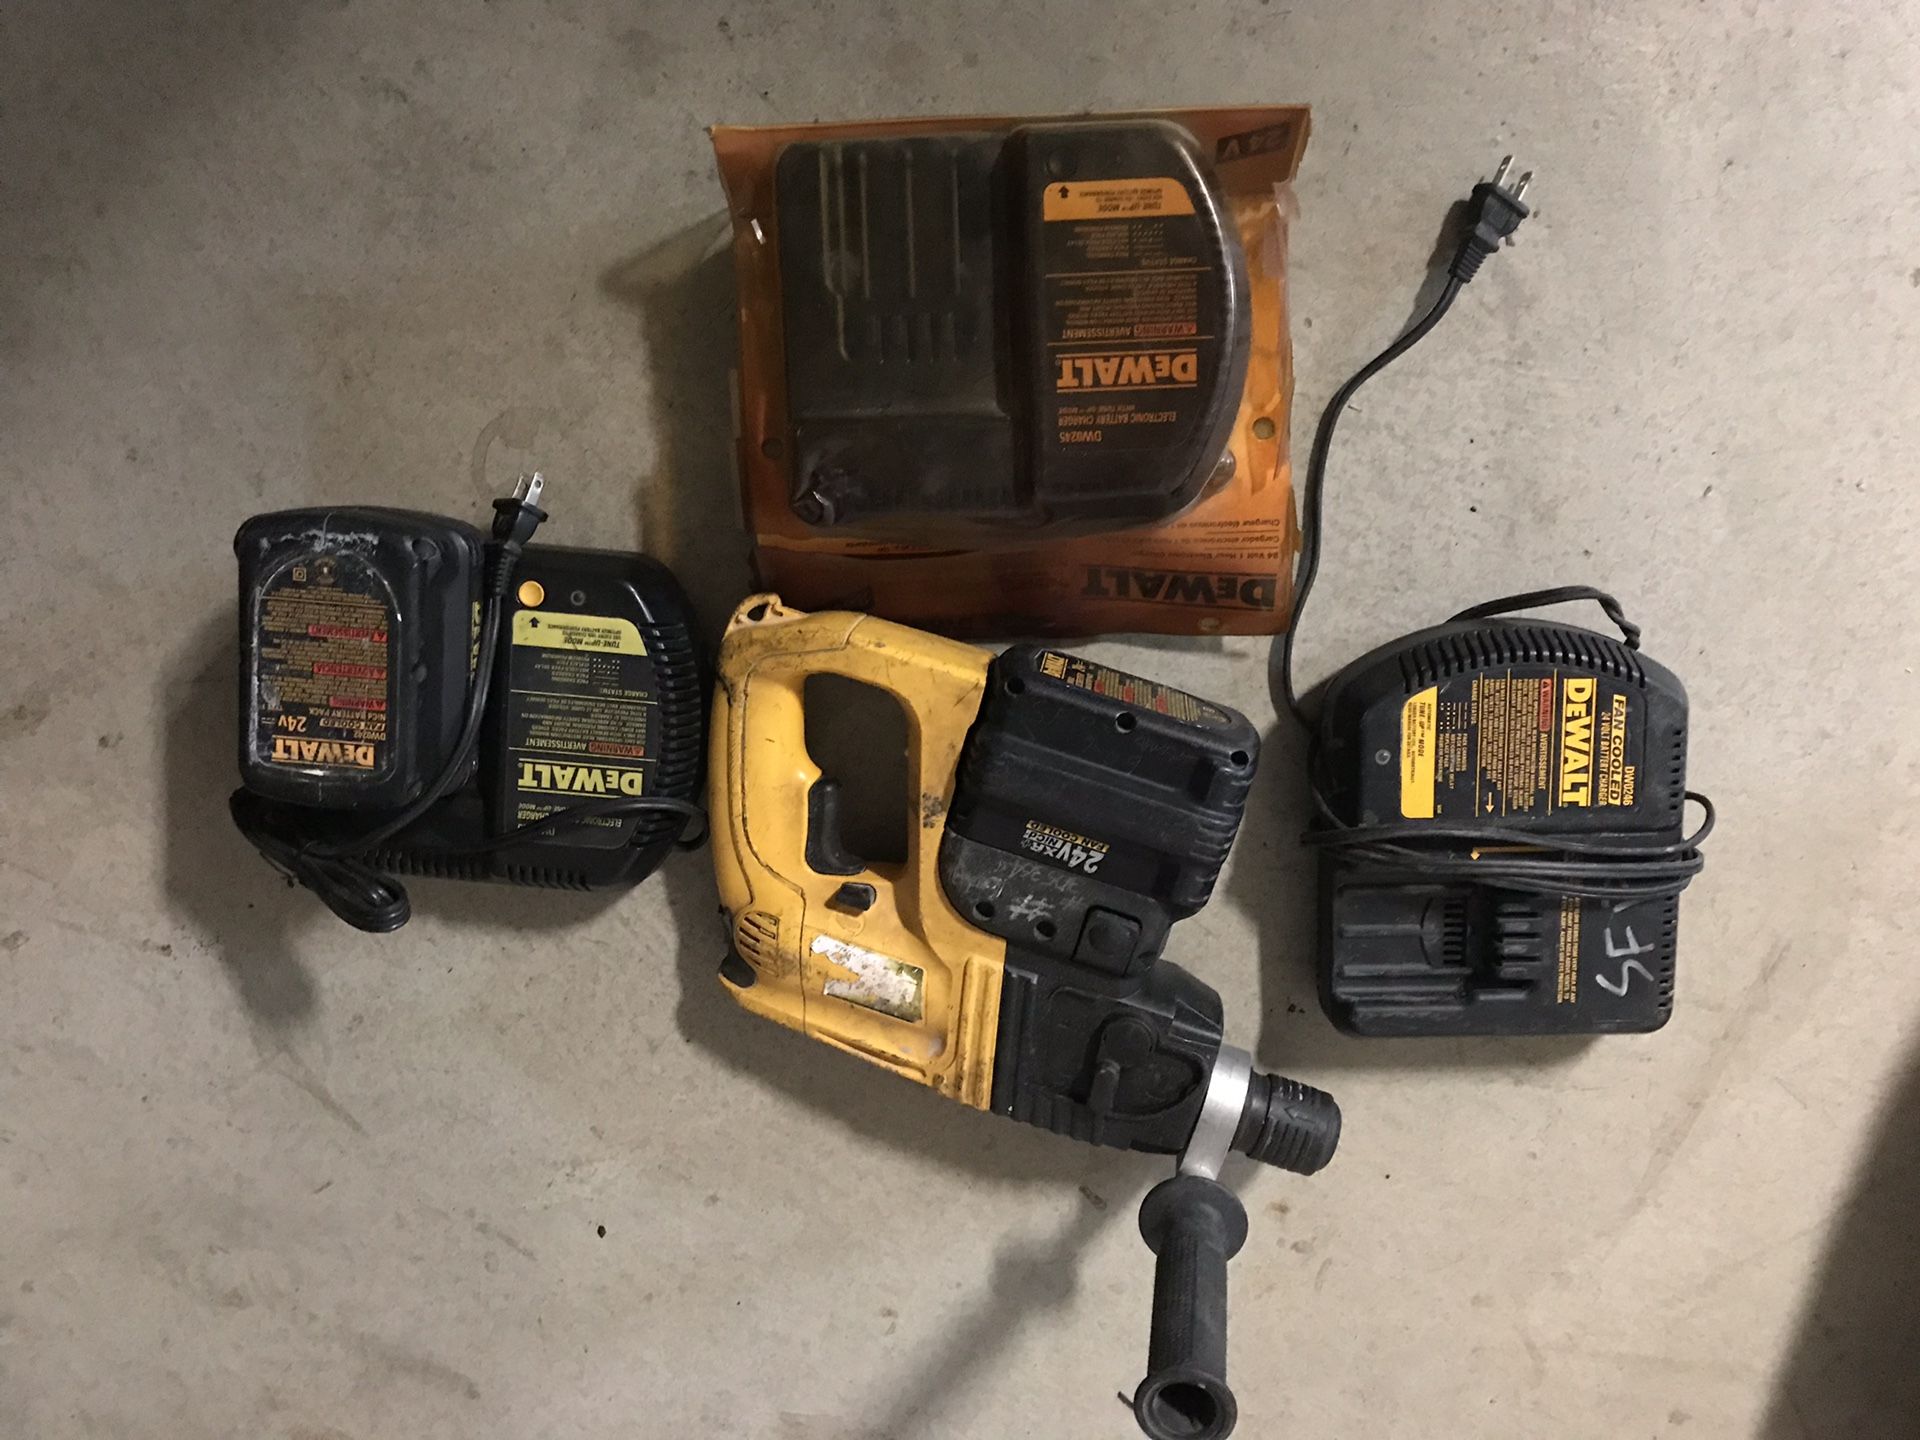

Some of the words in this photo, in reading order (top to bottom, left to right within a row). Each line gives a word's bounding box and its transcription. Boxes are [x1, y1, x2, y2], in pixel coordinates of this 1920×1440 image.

[1062, 327, 1131, 338] AVERTISSEMENT
[1057, 354, 1197, 387] DEWALT
[1058, 415, 1093, 426] CHARGER
[1097, 414, 1128, 424] BATTERY
[1131, 412, 1176, 423] ELECTRONIC
[1081, 567, 1277, 609] DEWALT
[309, 707, 329, 716] PACK
[331, 710, 366, 719] BATTERY
[1541, 690, 1550, 730] WARNING
[1601, 712, 1611, 720] 24
[1613, 698, 1625, 730] FAN
[525, 738, 586, 750] AVERTISSEMENT
[1562, 678, 1593, 807] DEWALT
[1600, 722, 1610, 739] VOLT
[271, 738, 374, 766] DEWALT
[590, 742, 633, 754] WARNING
[1538, 733, 1548, 790] AVERTISSEMENT
[1599, 741, 1610, 772] BATTERY
[518, 764, 643, 795] DEWALT
[1610, 735, 1623, 801] COOLED
[1598, 774, 1608, 806] CHARGER
[1623, 766, 1635, 806] DW0246
